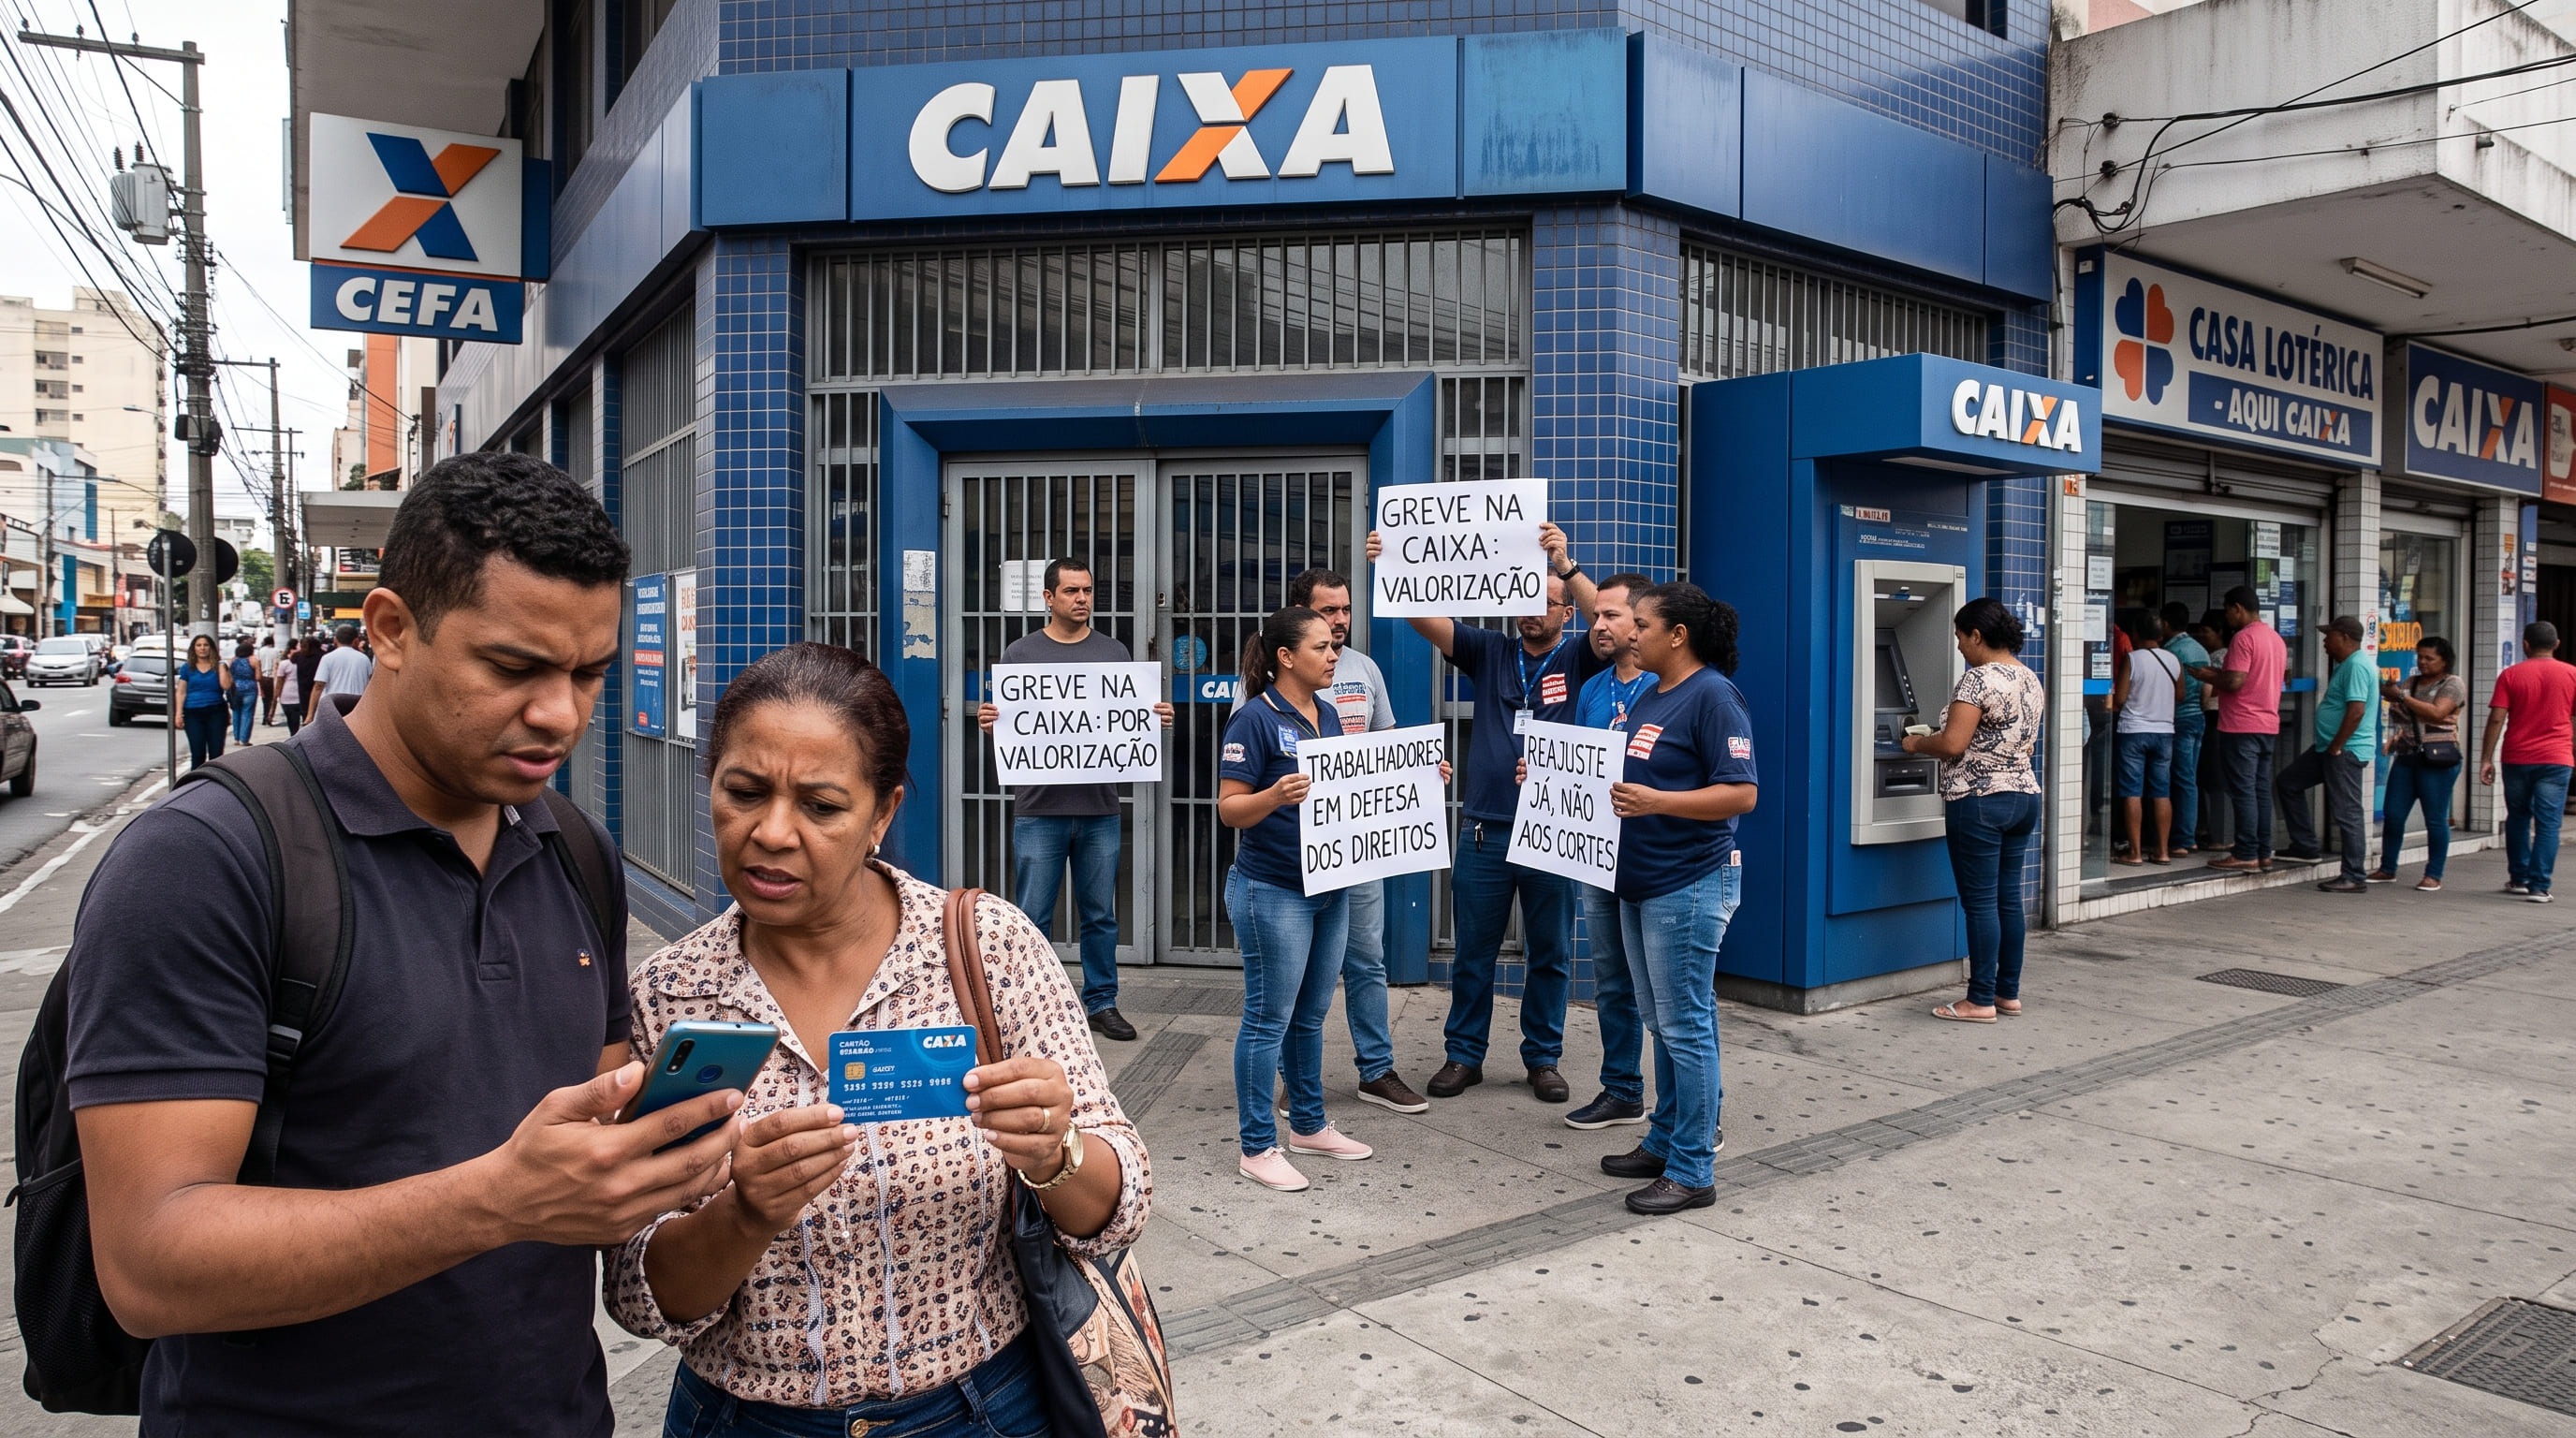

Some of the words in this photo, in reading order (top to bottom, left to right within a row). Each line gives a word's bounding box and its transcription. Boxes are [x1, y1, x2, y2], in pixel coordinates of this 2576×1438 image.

[908, 64, 1395, 194] CAIXA
[336, 276, 498, 332] CEFA
[2188, 306, 2257, 374] CASA
[2264, 324, 2374, 402] LOTÉRICA
[1952, 378, 2083, 454] CAIXA
[2227, 388, 2279, 433] AQUI
[2285, 401, 2351, 447] CAIXA
[2413, 374, 2538, 470] CAIXA
[1382, 494, 1471, 528] GREVE
[1486, 493, 1524, 521] NA
[1382, 565, 1541, 606] VALORIZAÇÃO
[1001, 674, 1087, 702] GREVE
[1102, 673, 1137, 700] NA
[1107, 708, 1151, 734] POR
[999, 737, 1158, 773] VALORIZAÇÃO
[1306, 739, 1443, 785] TRABALHADORES
[1528, 735, 1607, 780] REAJUSTE
[1313, 795, 1342, 827] EM
[1351, 783, 1420, 821] DEFESA
[1530, 775, 1557, 816] JÁ,
[1560, 786, 1594, 823] NÃO
[1307, 839, 1343, 874] DOS
[1352, 821, 1437, 865] DIREITOS
[1517, 819, 1553, 853] AOS
[1557, 829, 1616, 873] CORTES
